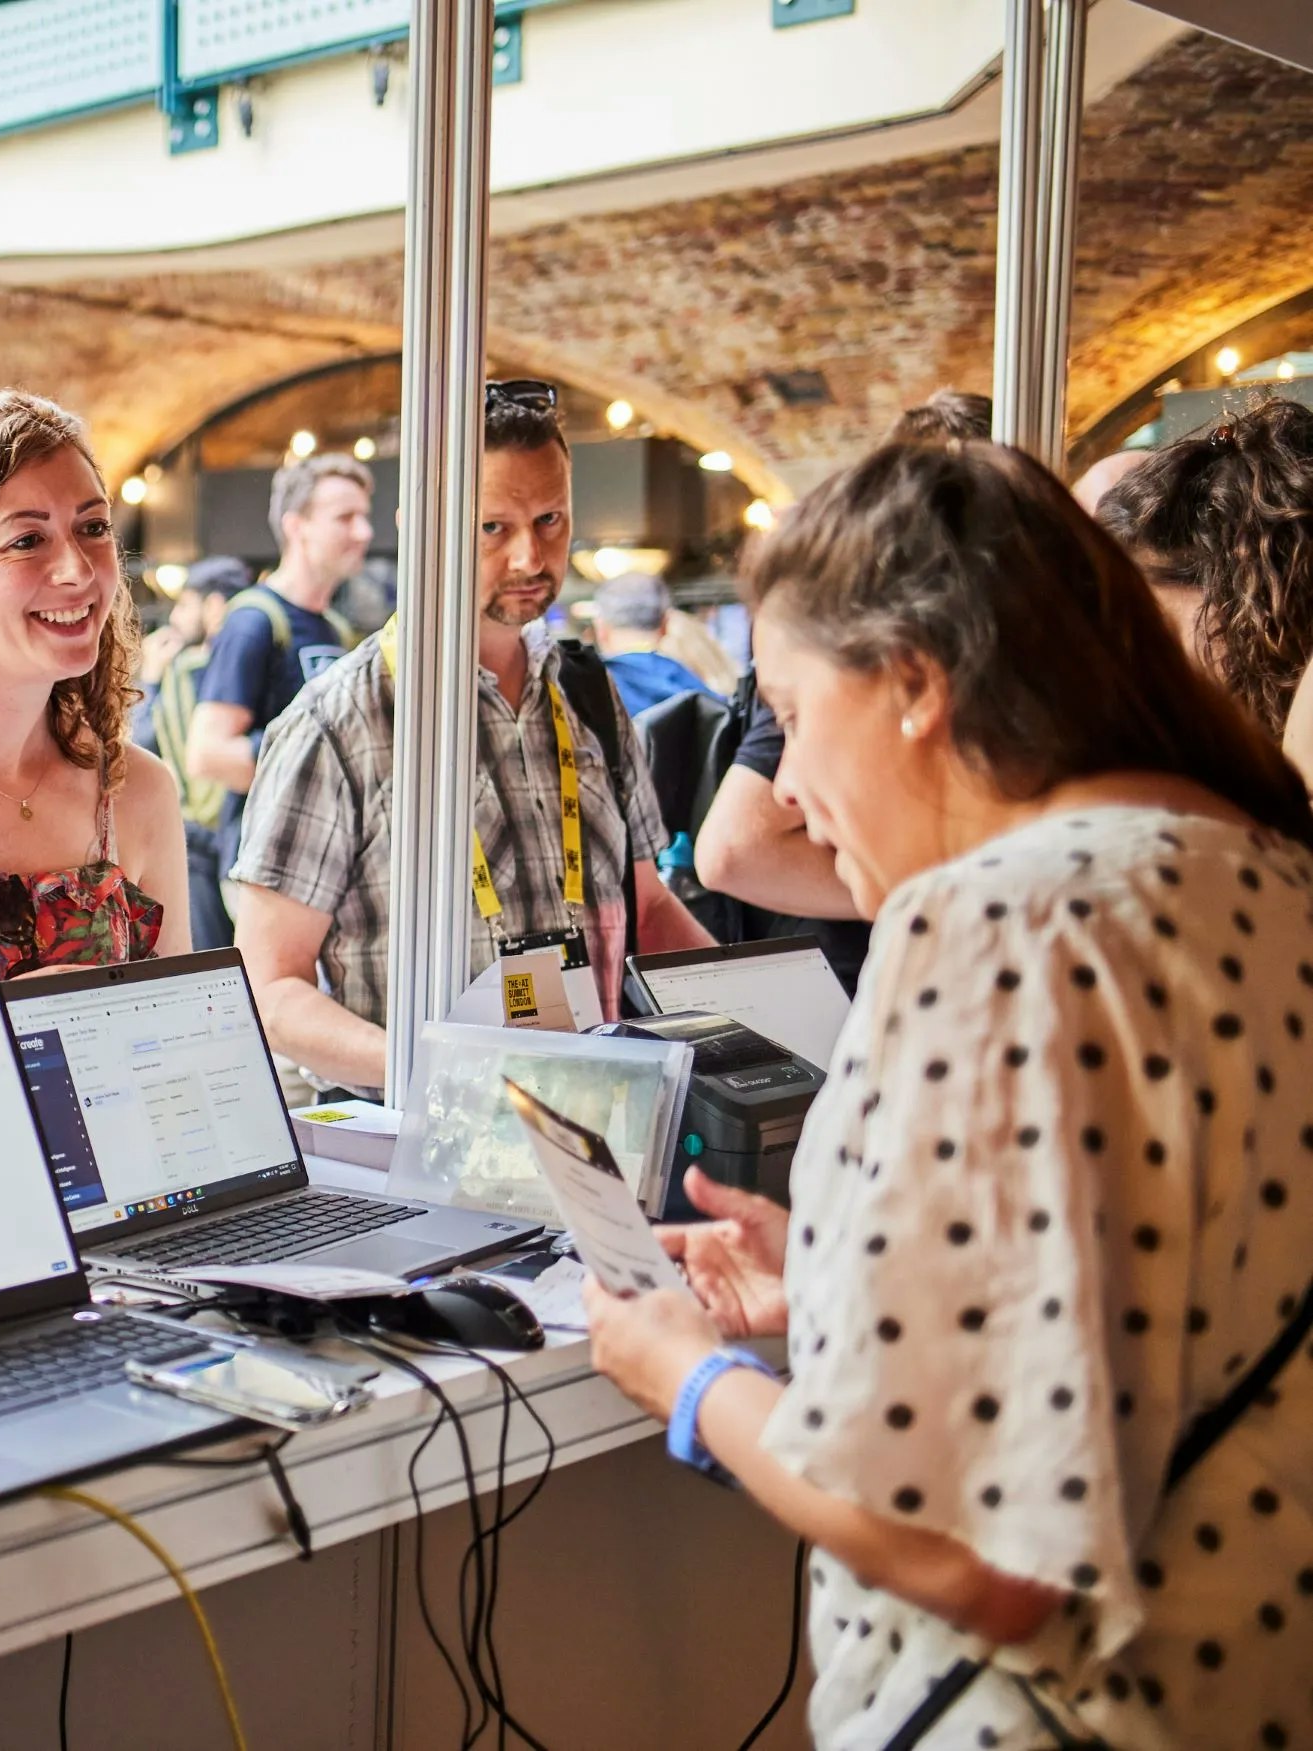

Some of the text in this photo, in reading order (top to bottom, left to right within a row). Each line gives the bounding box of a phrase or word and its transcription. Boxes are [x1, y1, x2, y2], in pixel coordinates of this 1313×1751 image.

[508, 980, 519, 988] THE
[509, 997, 531, 1007] LONDON
[181, 1204, 199, 1216] DELL
